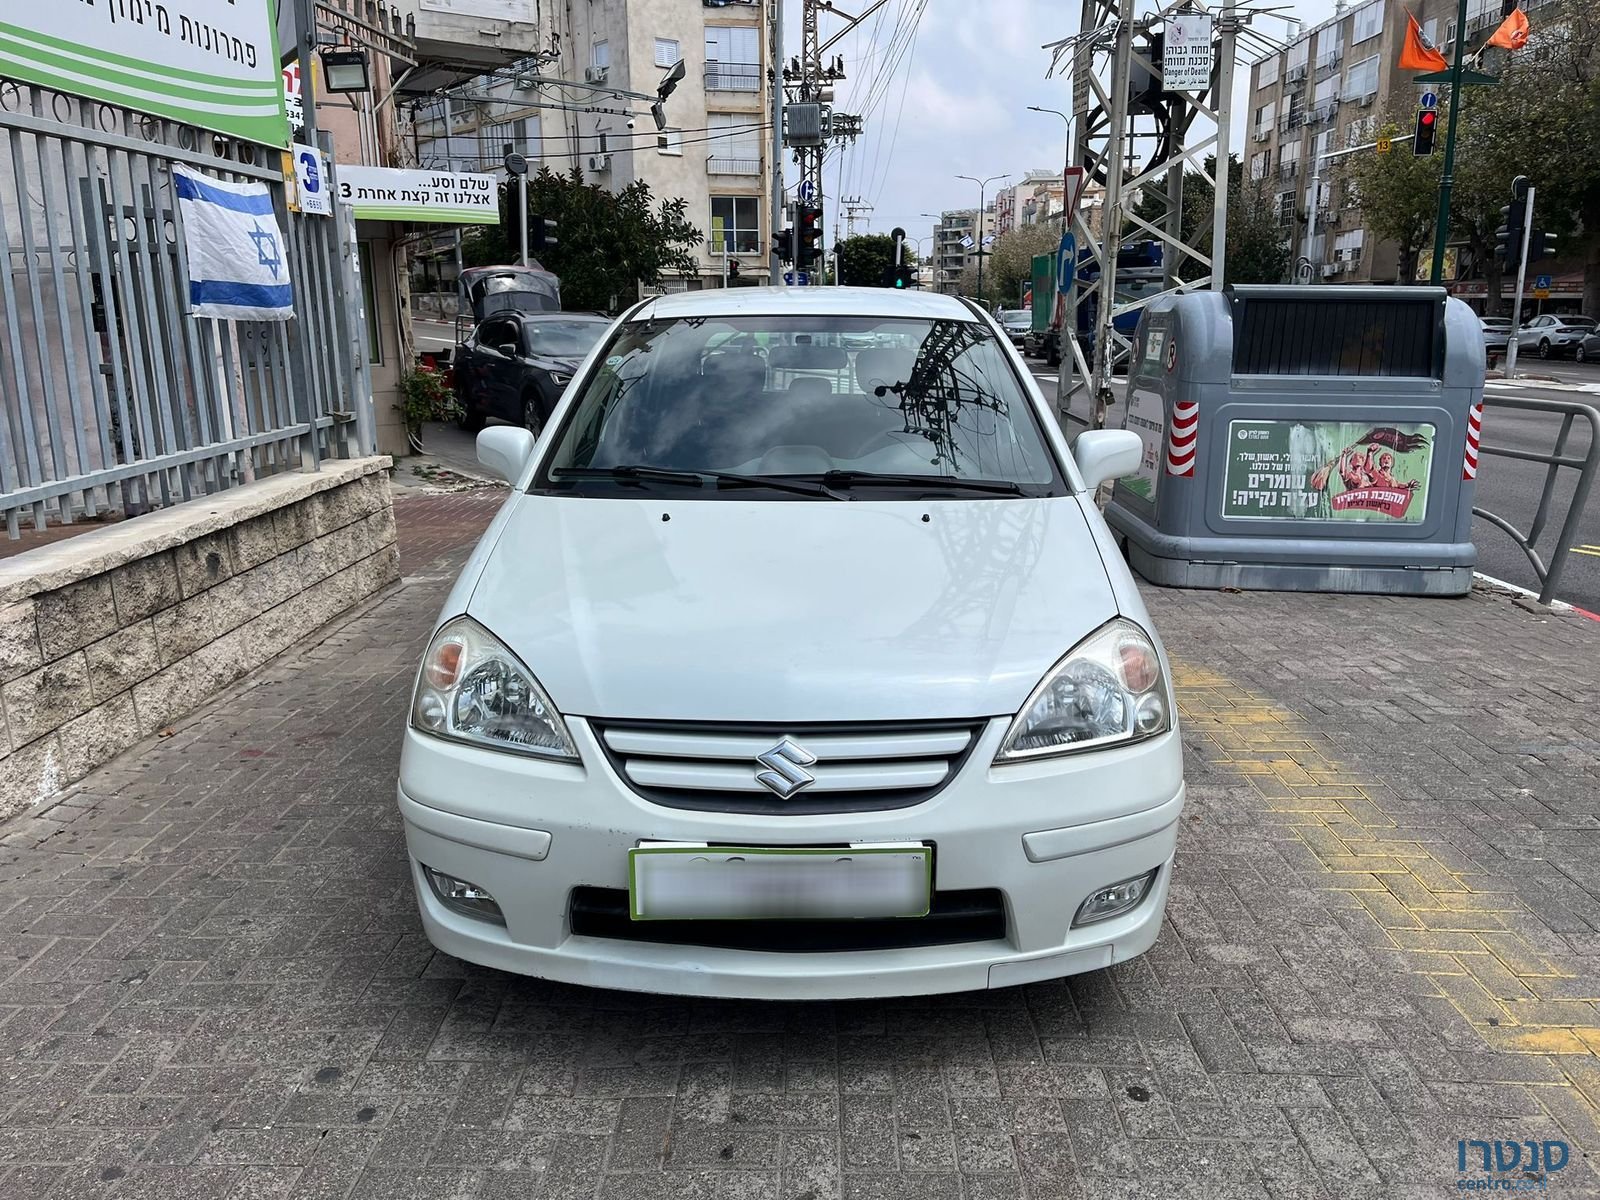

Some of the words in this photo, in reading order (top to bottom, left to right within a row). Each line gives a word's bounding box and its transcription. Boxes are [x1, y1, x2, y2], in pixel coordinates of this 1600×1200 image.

[108, 0, 171, 36] מימון
[179, 14, 257, 69] פתרונות
[1165, 45, 1188, 55] גבוה!
[1191, 45, 1209, 55] מתח
[1164, 57, 1186, 66] מוות!
[1188, 56, 1209, 66] סכנת
[1164, 67, 1184, 78] Danger
[1184, 67, 1190, 76] of
[1379, 141, 1388, 149] 13
[418, 176, 456, 189] וסע...
[459, 177, 489, 191] שלם
[357, 187, 397, 201] אחרת
[400, 189, 431, 205] קצת
[435, 190, 450, 203] זה
[454, 191, 491, 205] אצלנו
[1236, 452, 1256, 463] שלך,
[1255, 453, 1280, 464] ראשון
[1249, 462, 1271, 471] כולנו.
[1271, 462, 1283, 471] של
[1248, 473, 1307, 489] שומרים
[1232, 489, 1278, 509] נקייה!
[1370, 490, 1406, 505] מהפכת
